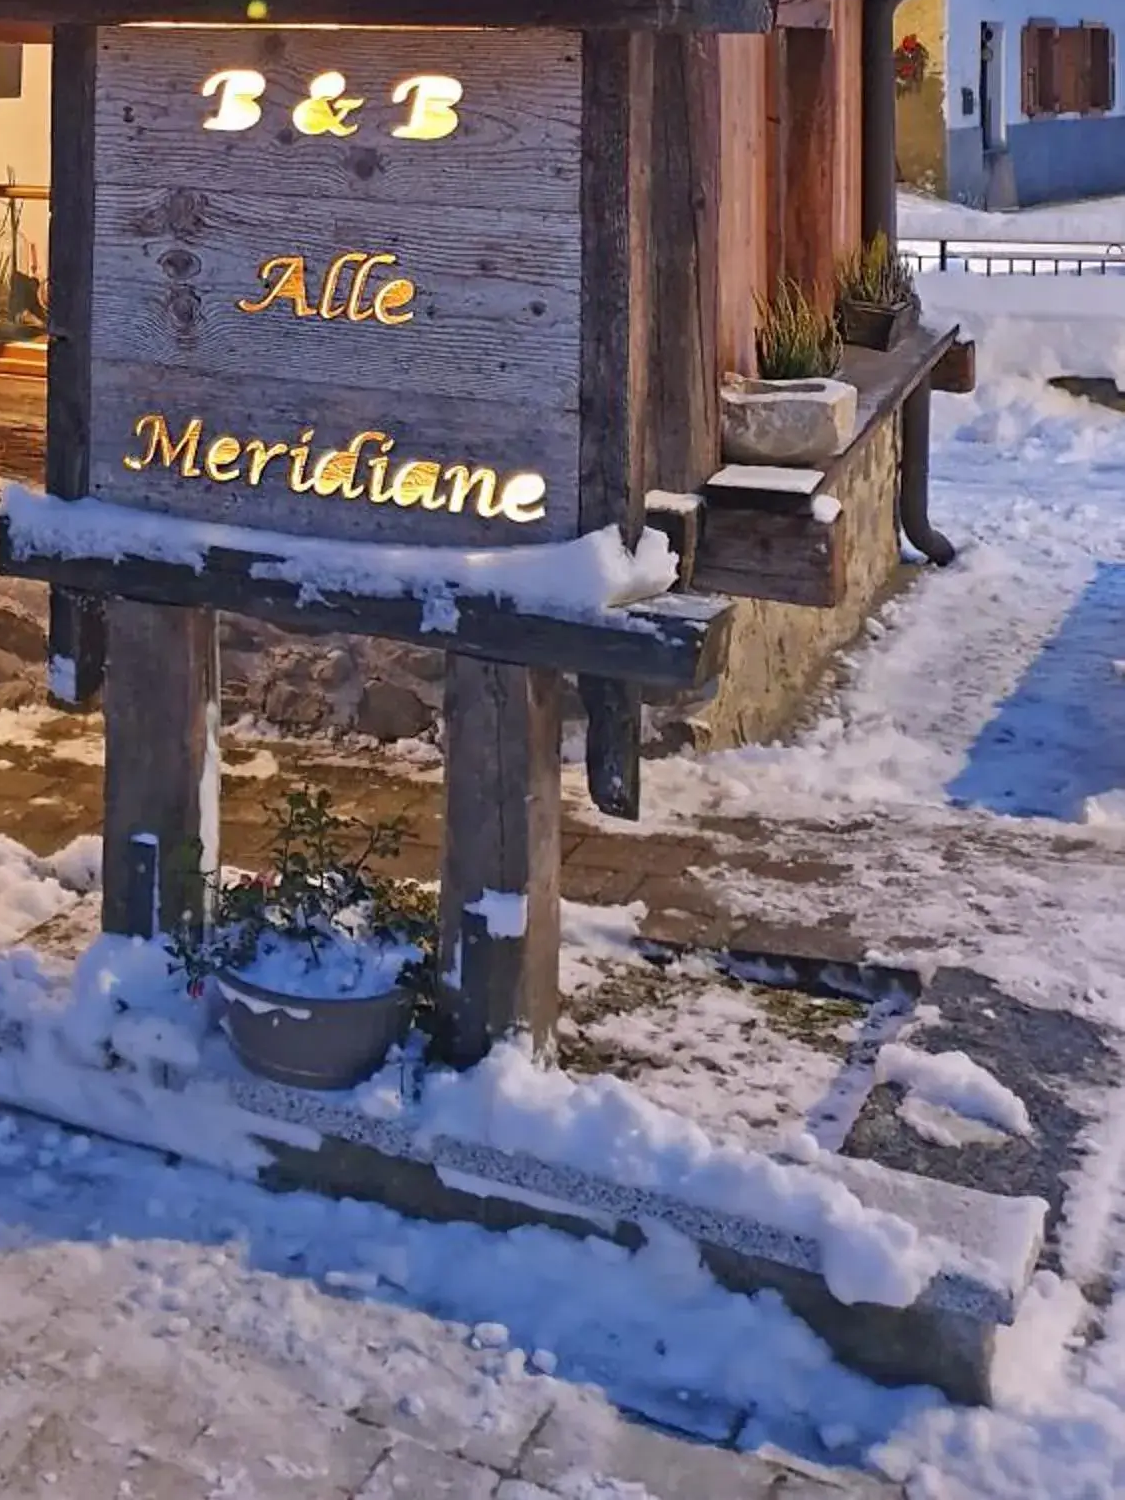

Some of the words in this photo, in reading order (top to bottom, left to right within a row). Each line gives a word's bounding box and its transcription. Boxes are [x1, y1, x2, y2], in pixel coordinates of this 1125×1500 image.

[202, 69, 266, 131] B
[292, 71, 364, 137] &
[392, 75, 464, 140] B
[238, 253, 416, 325] Alle
[124, 414, 546, 523] Meridiane
